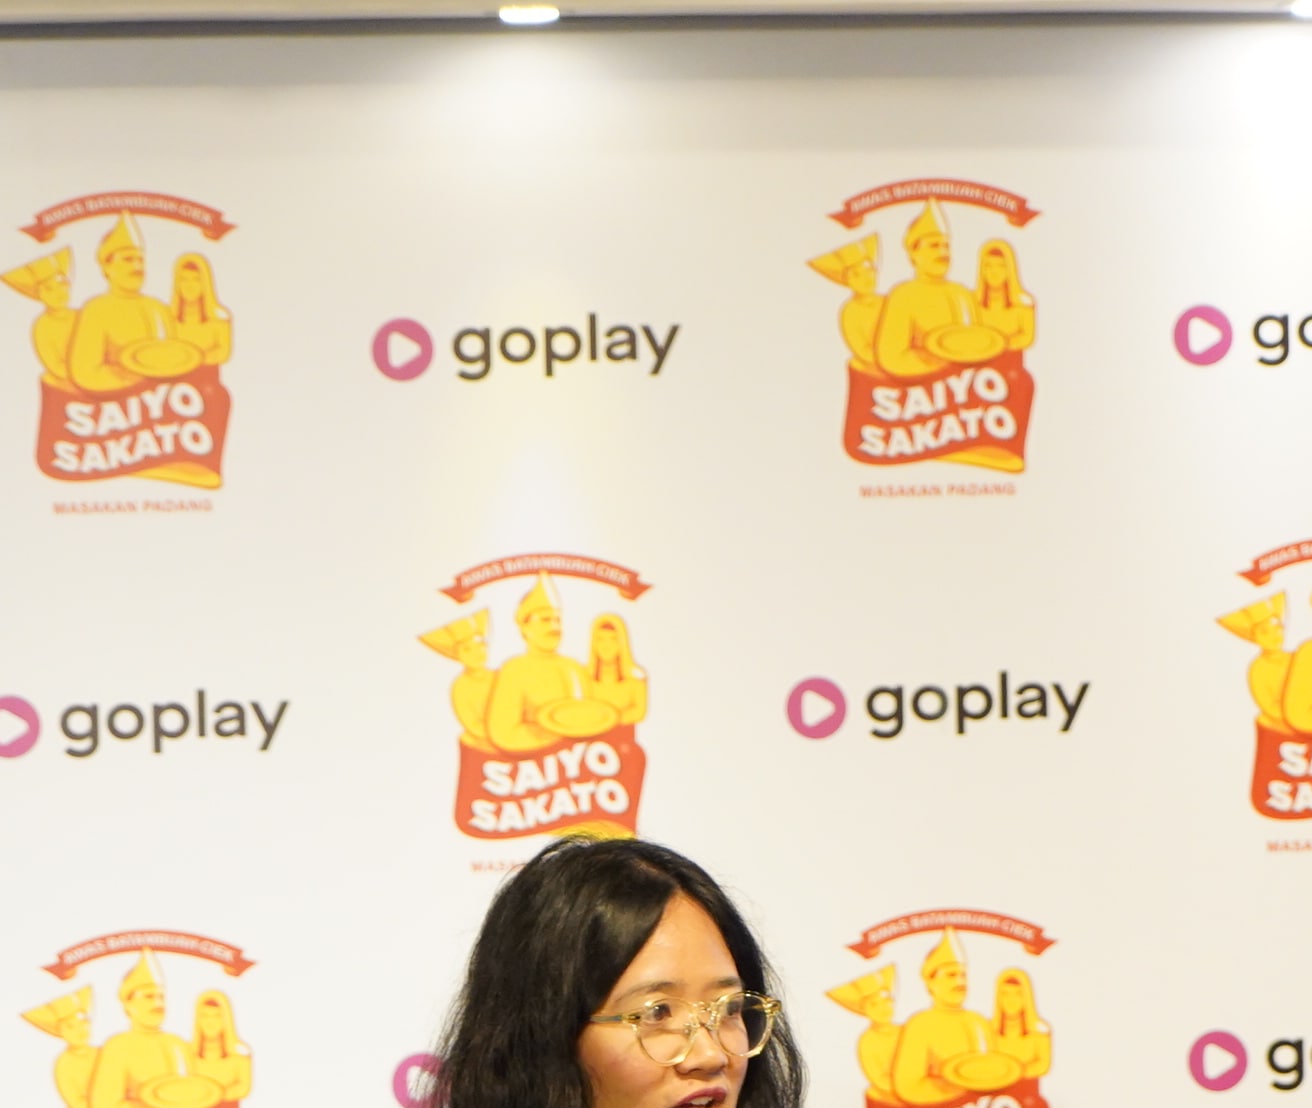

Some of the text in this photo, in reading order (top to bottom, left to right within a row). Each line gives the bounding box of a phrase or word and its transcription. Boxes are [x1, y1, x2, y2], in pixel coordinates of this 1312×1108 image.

[452, 313, 680, 382] goplay
[65, 382, 204, 437] SAIYO
[871, 367, 1008, 421] SAIYO
[52, 420, 213, 473] SAKATO
[859, 405, 1017, 457] SAKATO
[860, 482, 1016, 497] MASAKAN PADANG
[60, 689, 289, 758] goplay
[866, 671, 1089, 739] goplay
[483, 741, 620, 796] SAIYO
[470, 778, 629, 832] SAKATO
